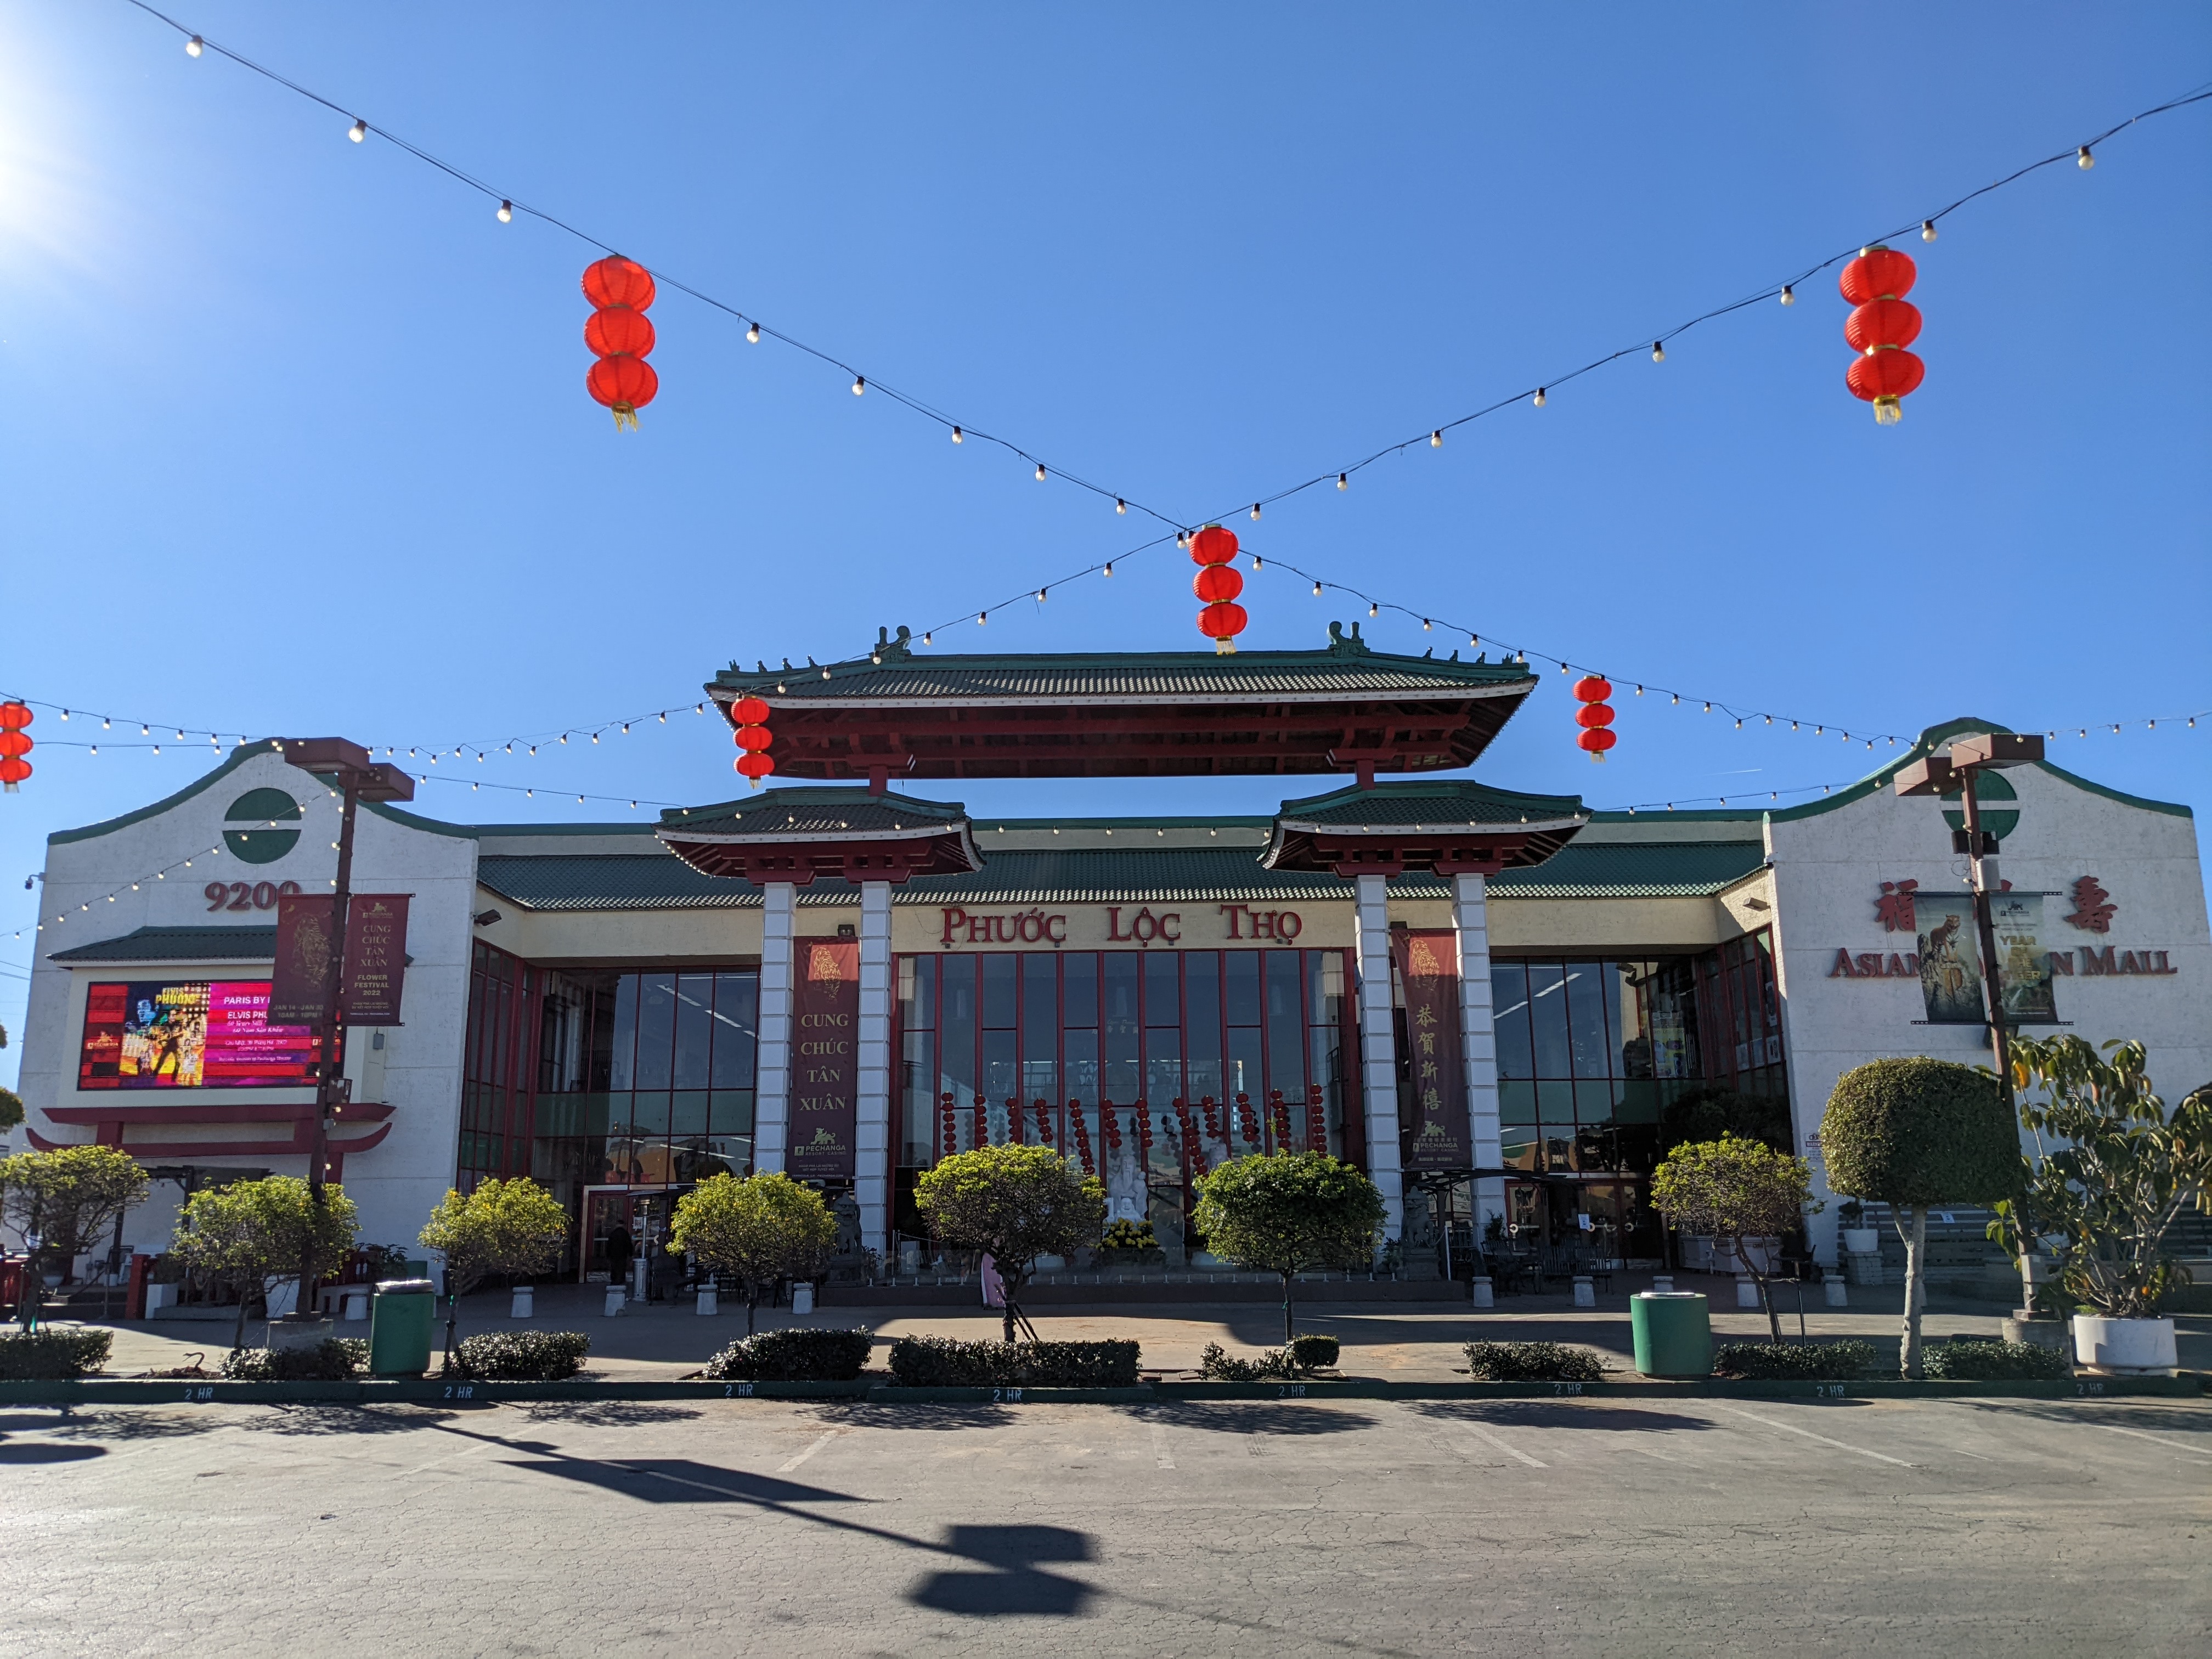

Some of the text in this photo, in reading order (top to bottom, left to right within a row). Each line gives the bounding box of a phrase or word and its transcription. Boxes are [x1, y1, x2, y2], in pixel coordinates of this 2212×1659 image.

[940, 907, 1066, 943] PHƯỚC
[1107, 906, 1181, 947] LỘC
[1999, 935, 2036, 945] YEAR
[2080, 945, 2177, 975] MALL
[228, 1011, 251, 1019] ELVIS
[801, 1014, 849, 1027] CUNG
[800, 1037, 849, 1055] CHÚC
[806, 1065, 840, 1082] TÂN
[799, 1093, 846, 1110] XUÂN
[184, 1387, 213, 1401] 2 HR
[444, 1386, 473, 1399] 2 HR
[725, 1384, 753, 1397] 2 HR
[994, 1389, 1022, 1402] 2 HR
[1279, 1385, 1306, 1397] 2 HR
[1555, 1383, 1582, 1395] 2 HR
[1816, 1385, 1845, 1398] 2 HR
[2076, 1383, 2103, 1395] 2 HR
